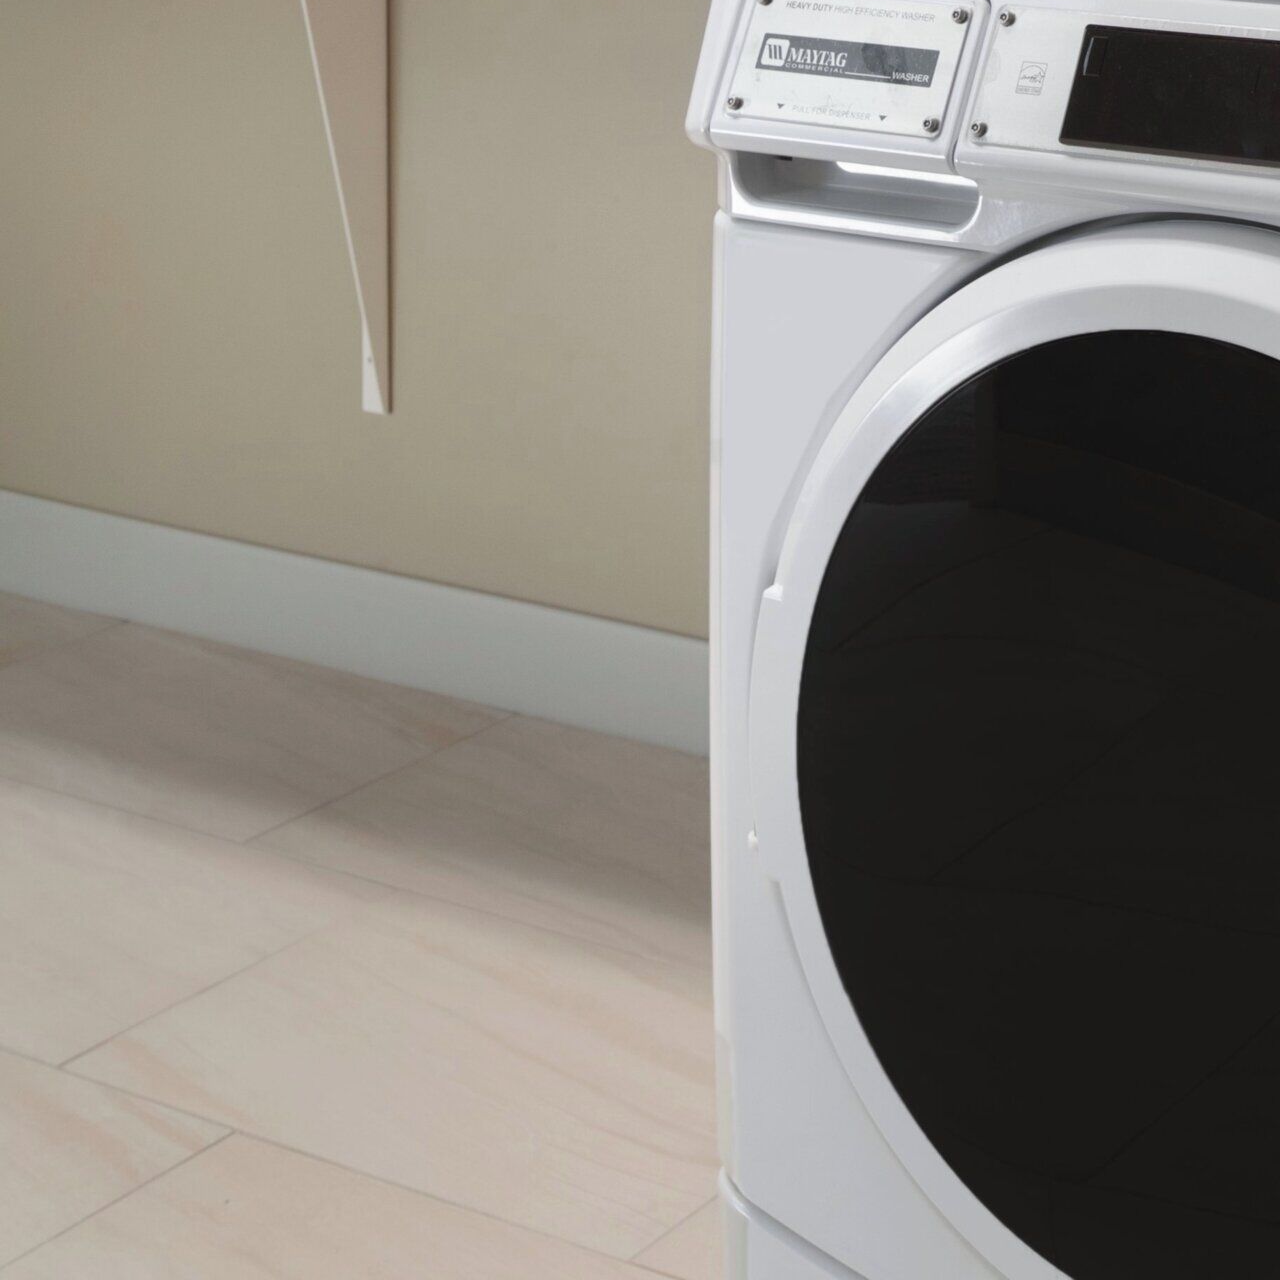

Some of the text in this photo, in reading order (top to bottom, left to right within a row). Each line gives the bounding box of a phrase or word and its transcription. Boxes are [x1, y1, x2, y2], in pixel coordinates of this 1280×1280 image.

[786, 0, 812, 10] HEAVY
[812, 2, 833, 12] DUTY
[834, 5, 853, 15] HIGH
[854, 7, 899, 19] EFFICIENCY
[787, 47, 848, 67] MAYTAG
[785, 62, 846, 74] COMMERCIAL
[892, 71, 930, 83] WASHER
